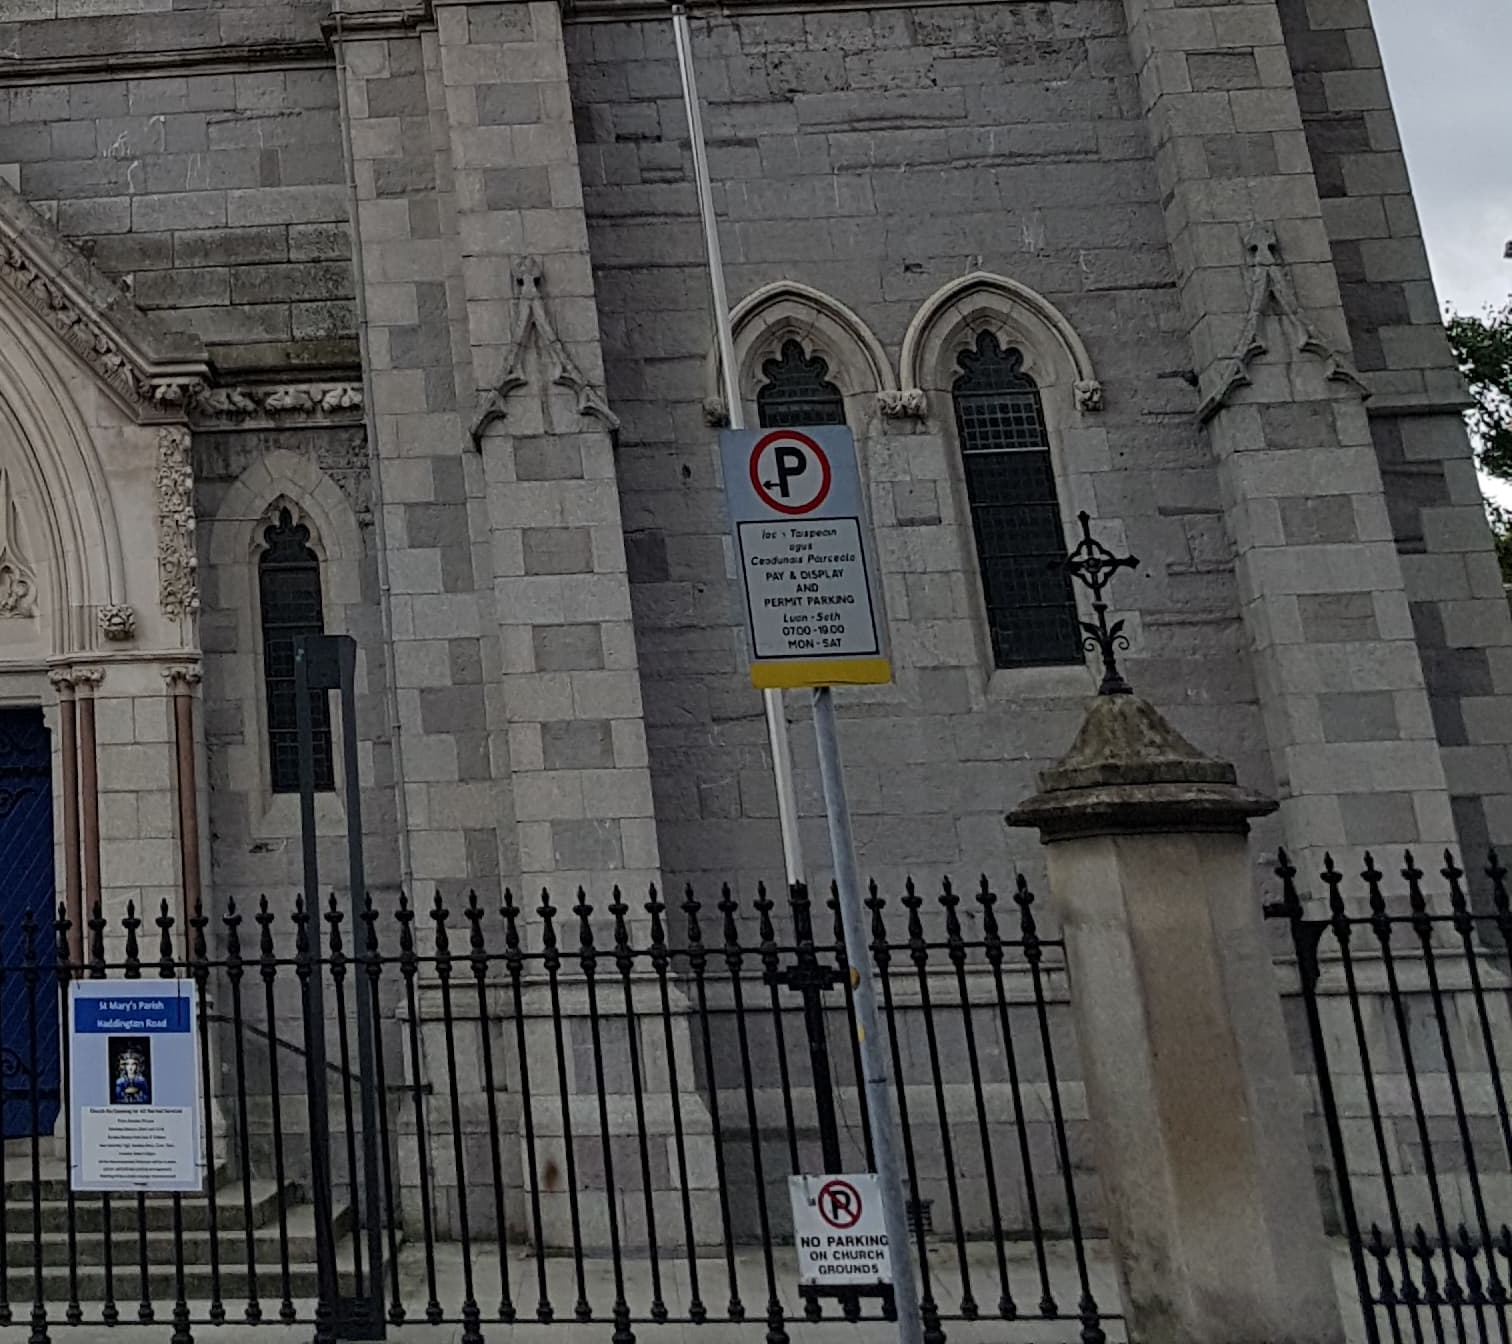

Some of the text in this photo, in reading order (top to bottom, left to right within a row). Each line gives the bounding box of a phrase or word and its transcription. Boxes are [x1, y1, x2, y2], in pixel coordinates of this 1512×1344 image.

[765, 568, 844, 581] PAY & DISPLAY
[796, 583, 819, 593] AND
[764, 594, 855, 608] PERMIT PARKING
[146, 1018, 168, 1028] Road
[801, 1235, 889, 1248] NO PARKING
[810, 1249, 885, 1261] ON CHURCH
[818, 1264, 879, 1275] GROUNDS
